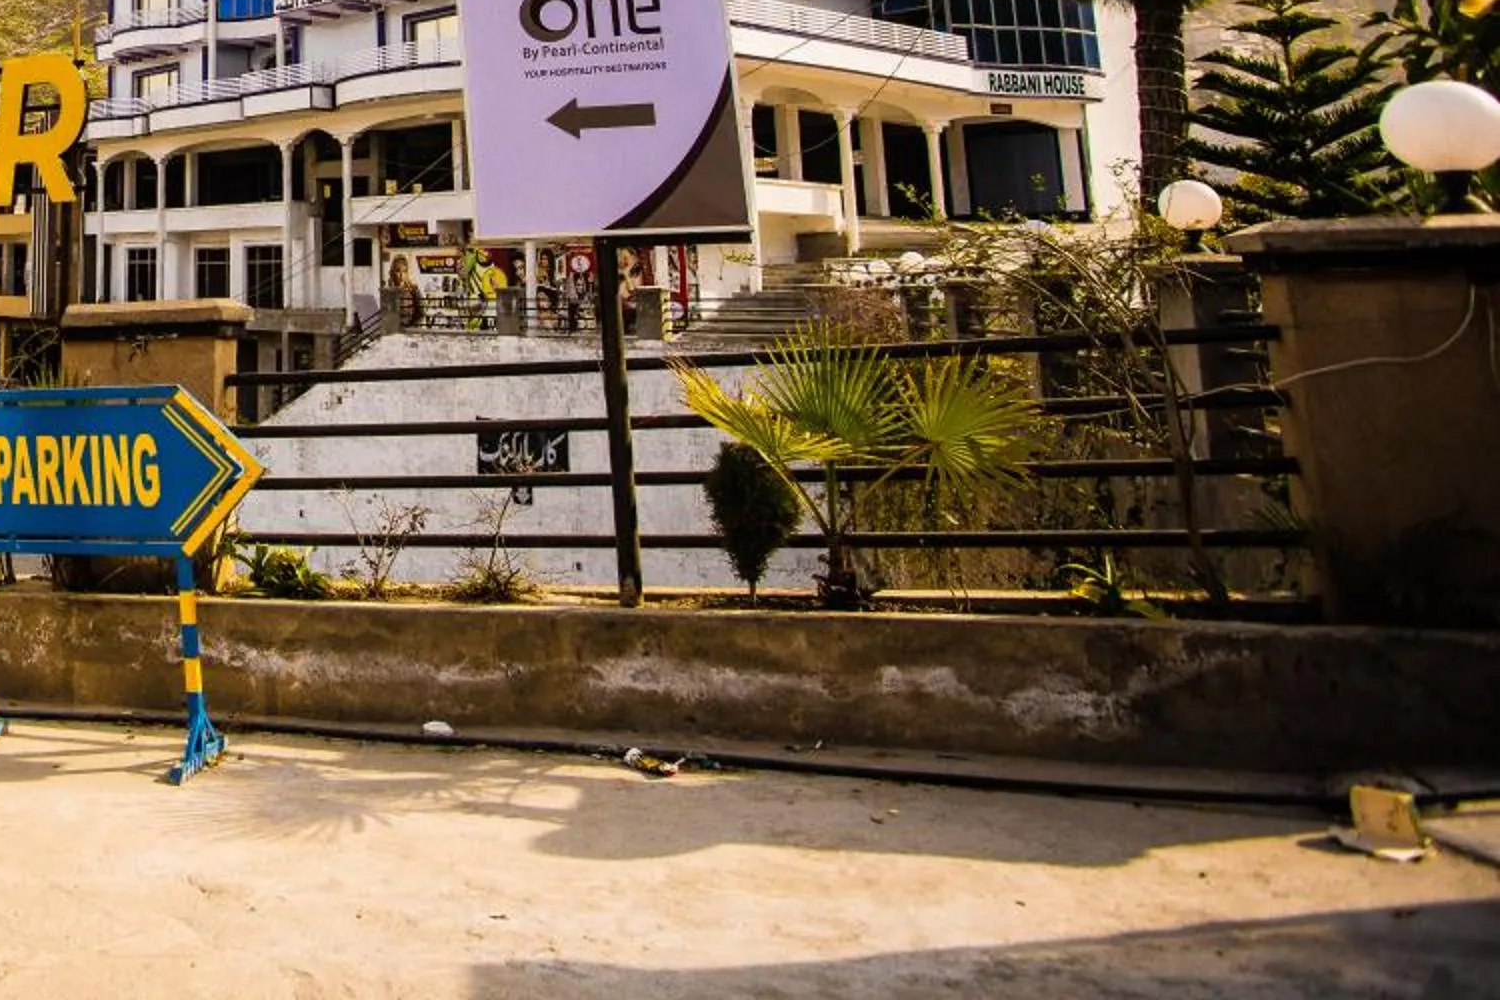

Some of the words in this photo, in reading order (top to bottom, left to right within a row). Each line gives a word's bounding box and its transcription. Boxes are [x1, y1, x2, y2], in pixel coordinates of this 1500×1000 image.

[522, 47, 539, 61] By
[542, 37, 665, 58] Pearl-Continental
[523, 68, 549, 79] YOUR
[550, 65, 603, 77] HOSPITALITY
[605, 60, 668, 74] DESTINATIONS
[988, 72, 1042, 94] RABBANI
[1044, 74, 1086, 95] HOUSE
